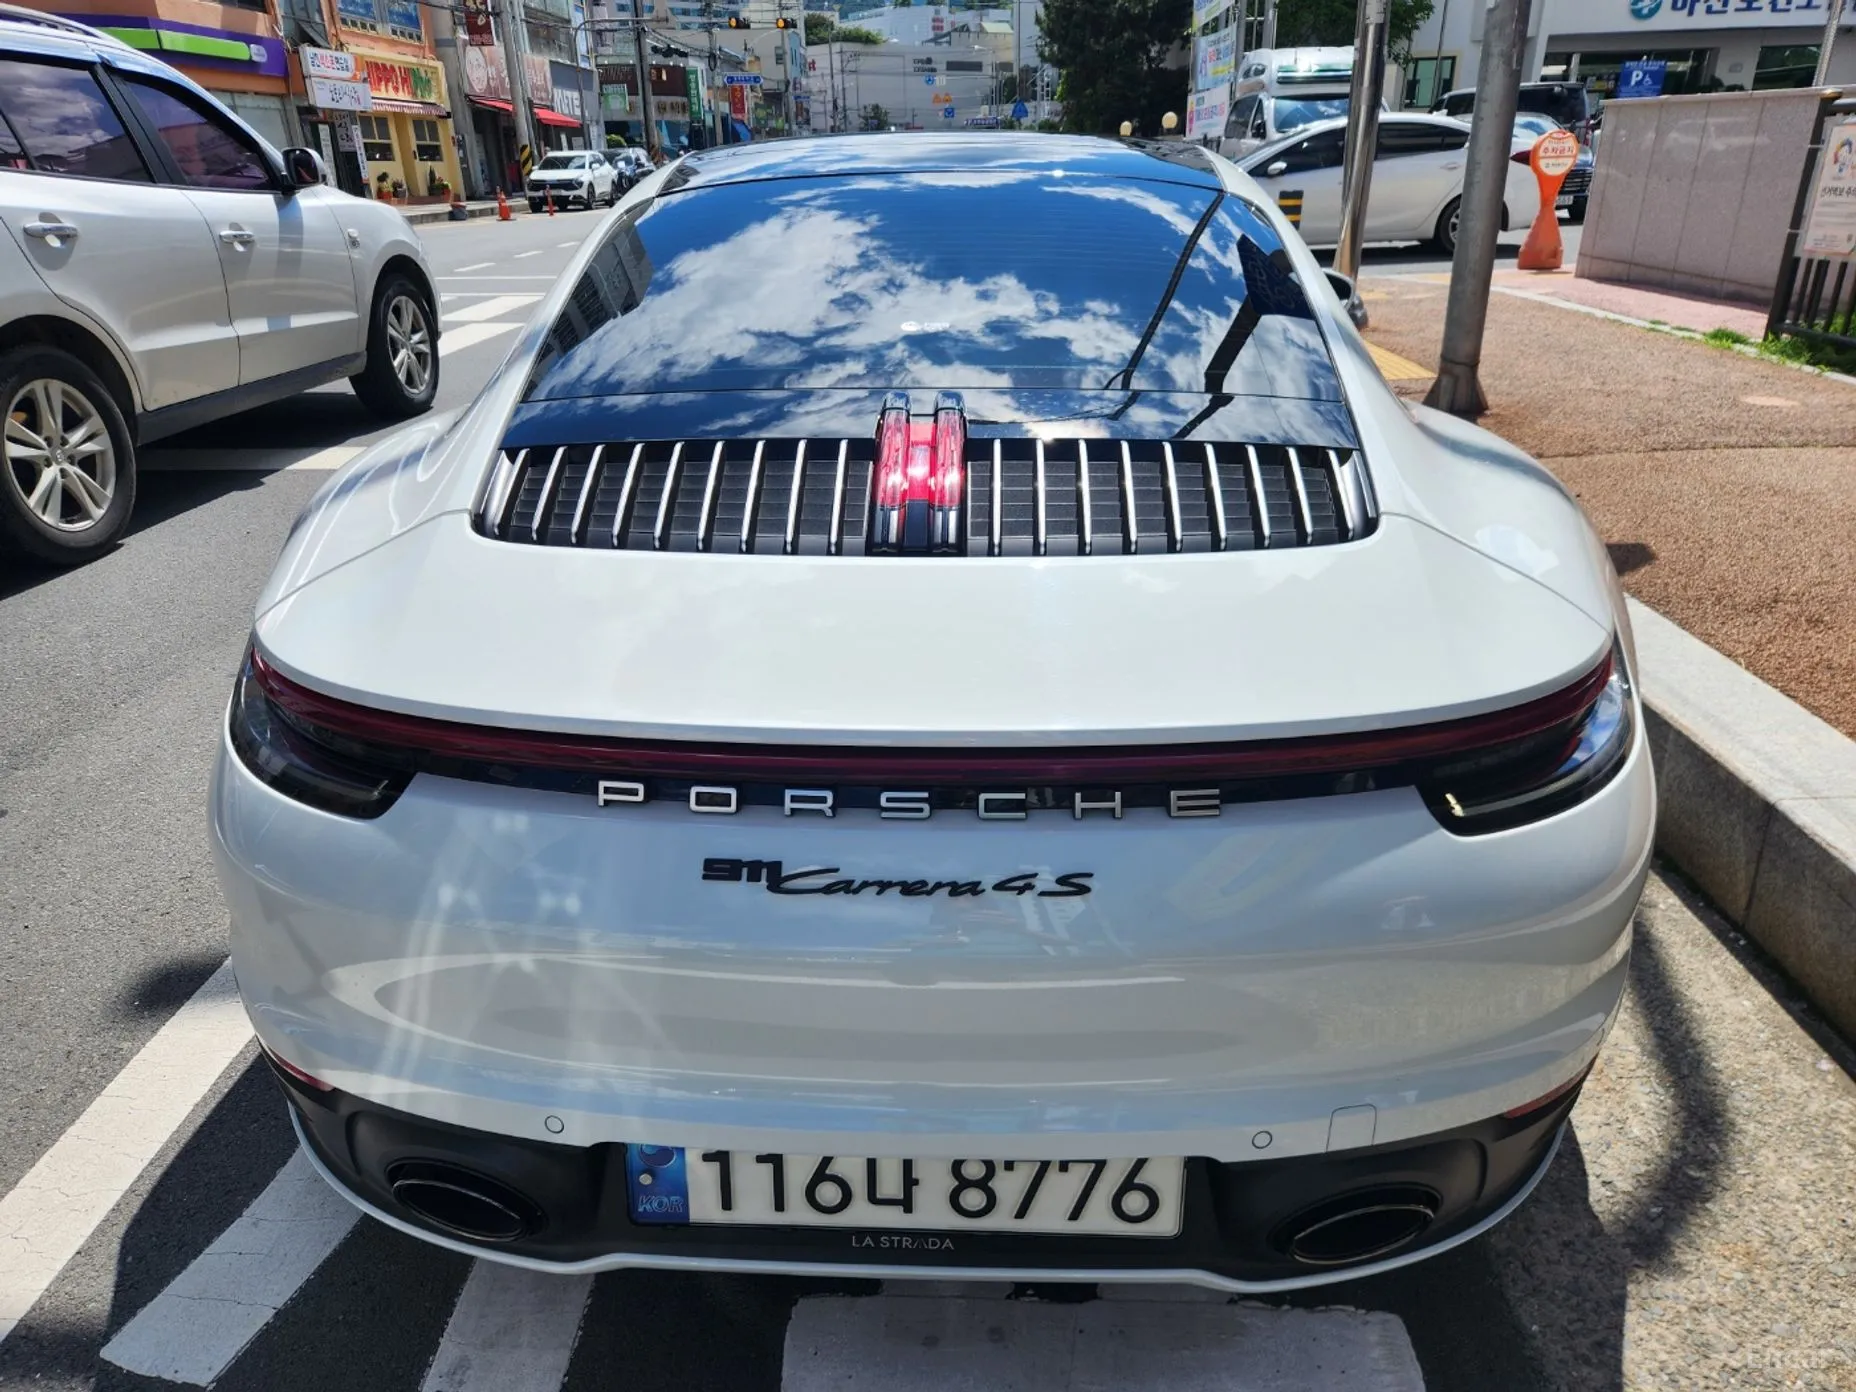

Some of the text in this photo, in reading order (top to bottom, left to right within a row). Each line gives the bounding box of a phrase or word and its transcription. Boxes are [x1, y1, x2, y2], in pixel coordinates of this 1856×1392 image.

[1543, 146, 1574, 155] 주차금지
[598, 780, 1221, 819] PORSCHE
[766, 867, 986, 897] Carrera
[637, 1195, 684, 1213] KOR
[851, 1235, 956, 1250] LA STRADA
